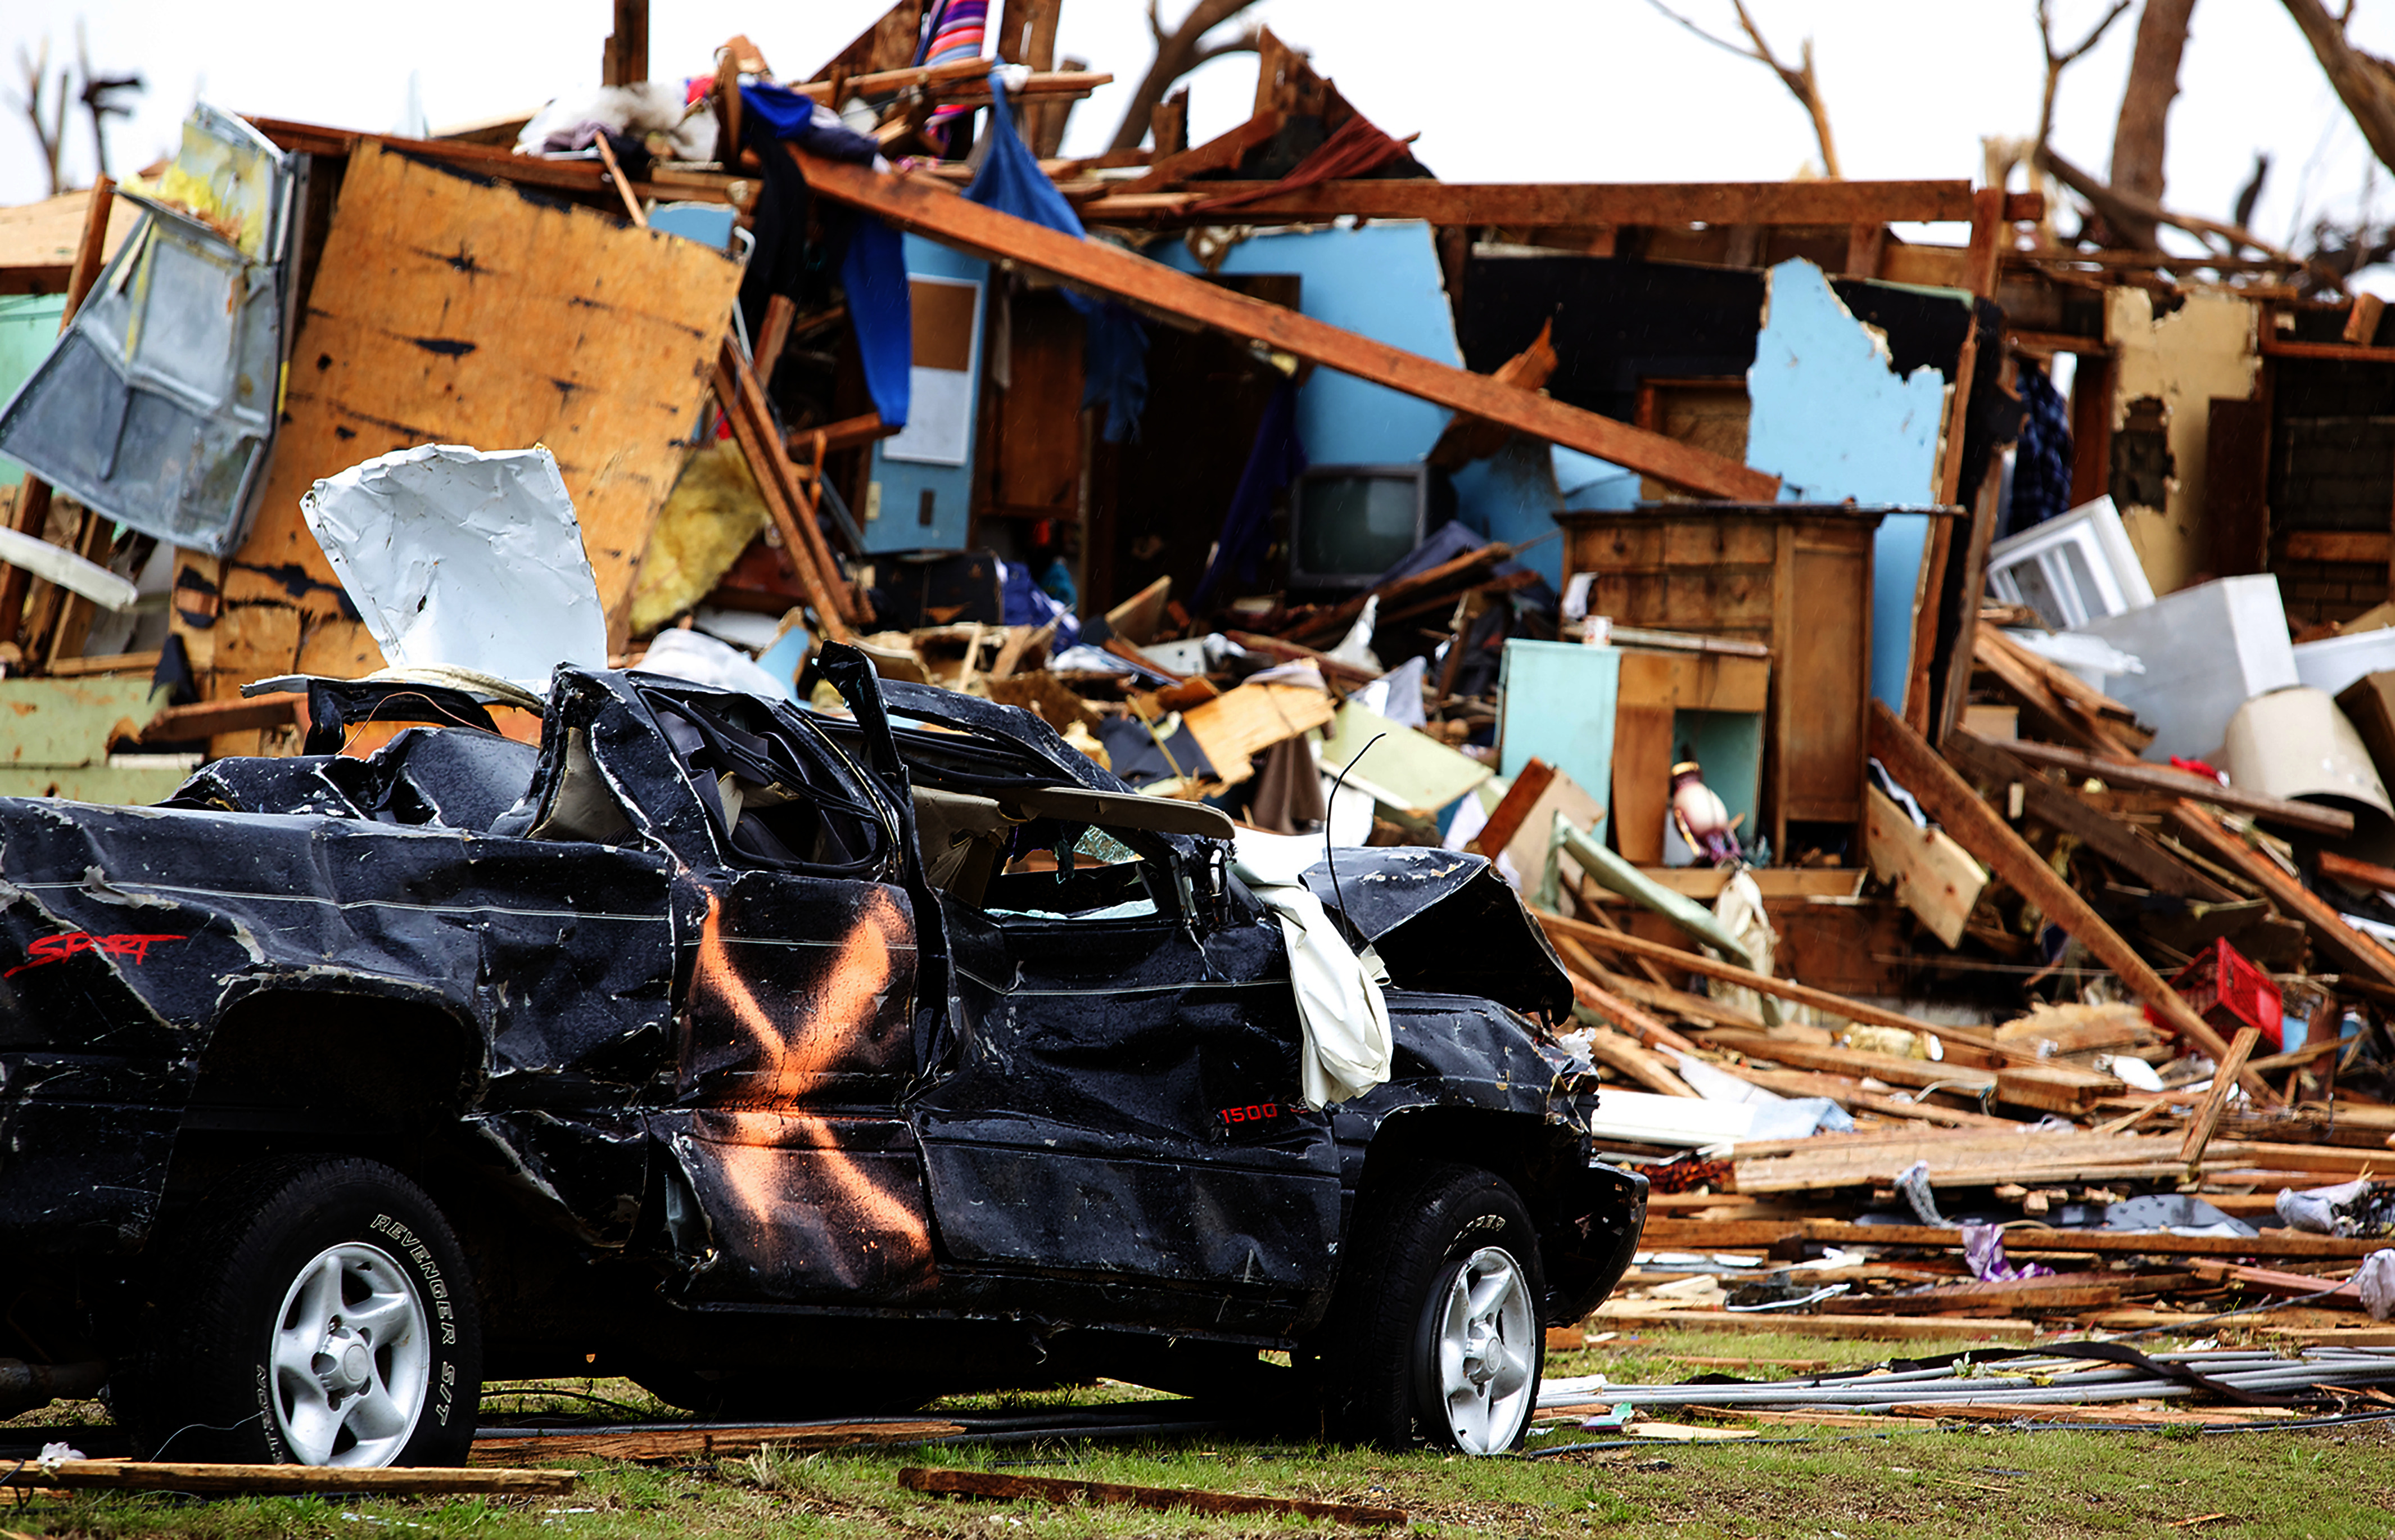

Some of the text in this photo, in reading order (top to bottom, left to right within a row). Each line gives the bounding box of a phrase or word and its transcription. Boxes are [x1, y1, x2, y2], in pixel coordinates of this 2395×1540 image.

[3, 931, 189, 981] SPORT
[1221, 1103, 1278, 1123] 1500
[370, 1214, 456, 1426] REVENGER S/T
